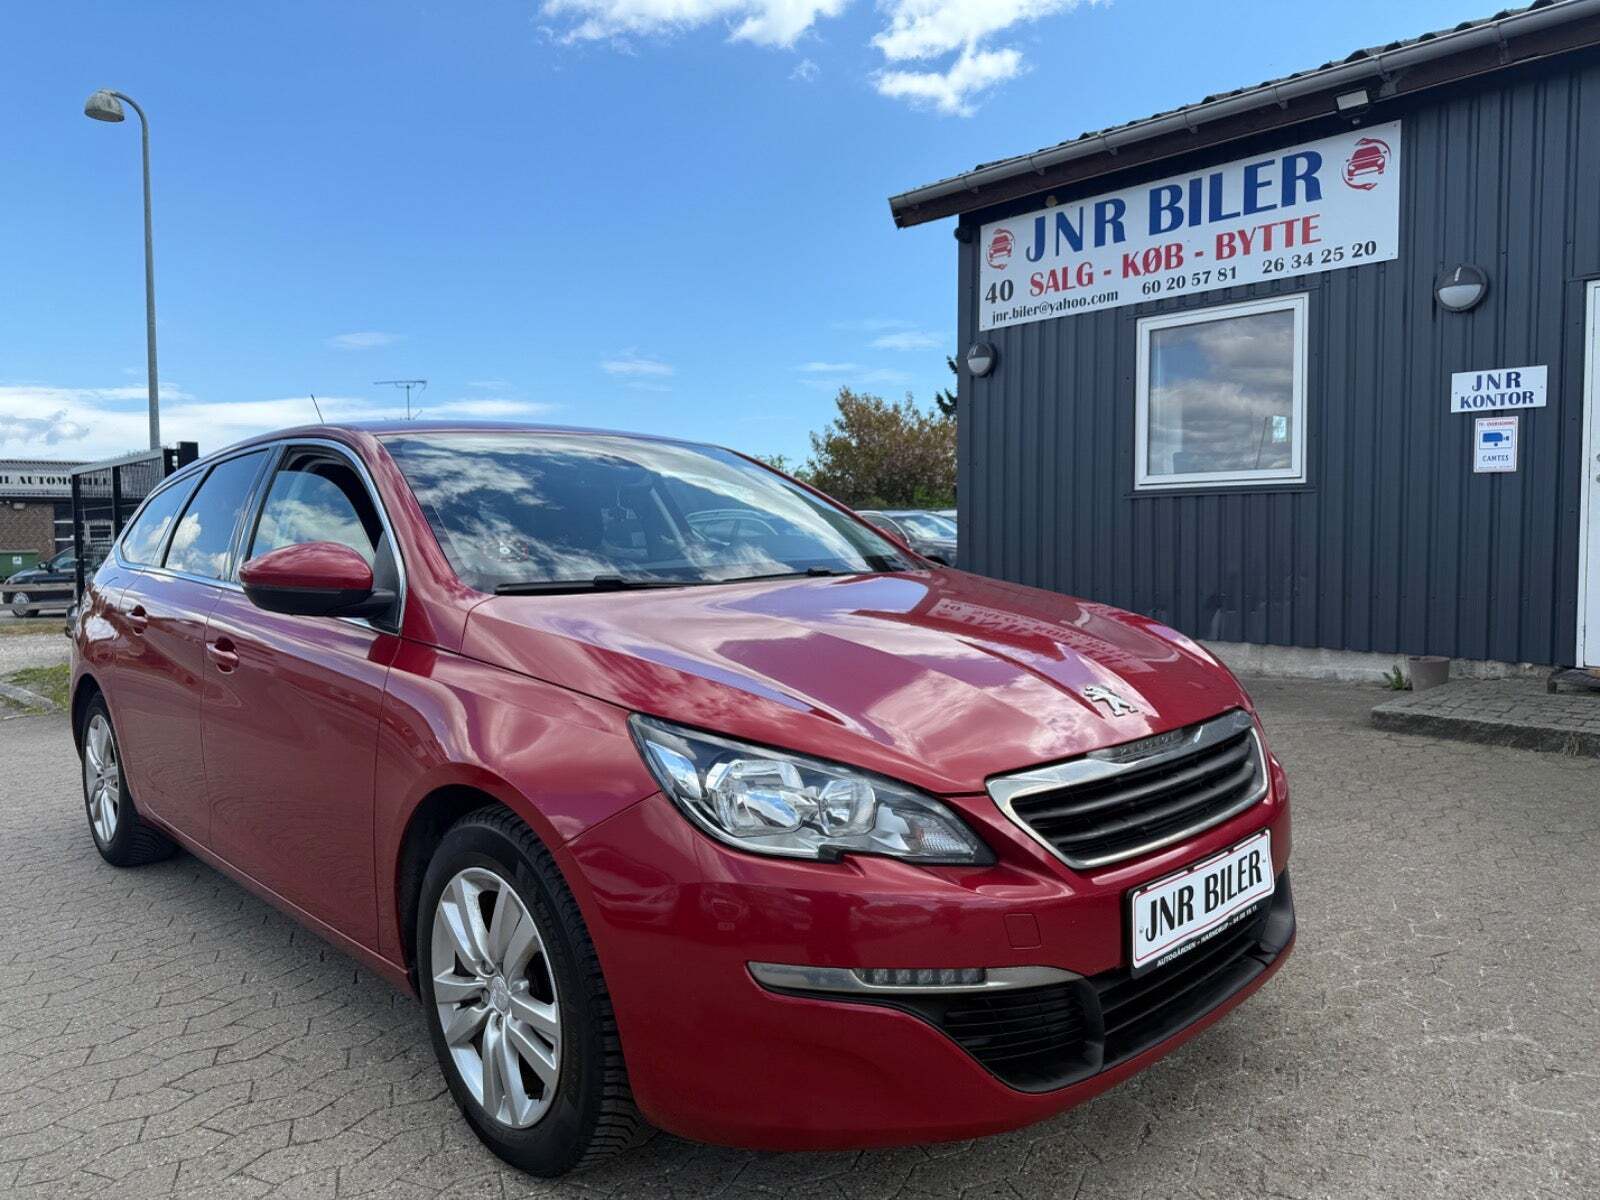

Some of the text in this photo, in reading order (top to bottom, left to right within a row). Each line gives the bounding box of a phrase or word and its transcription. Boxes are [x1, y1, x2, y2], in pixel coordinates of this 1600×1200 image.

[1026, 150, 1323, 262] JNR BILER
[1029, 261, 1094, 297] SALG
[1122, 240, 1184, 279] KØB
[1216, 214, 1322, 261] BYTTE
[1262, 240, 1377, 274] 26 34 25 20
[984, 279, 1014, 304] 40
[1142, 266, 1237, 295] 60 20 57 81
[991, 290, 1119, 325] jnr.biler@yahoo.com
[1472, 372, 1521, 391] JNR
[1461, 391, 1534, 409] KONTOR
[1145, 850, 1262, 942] JNR BILER
